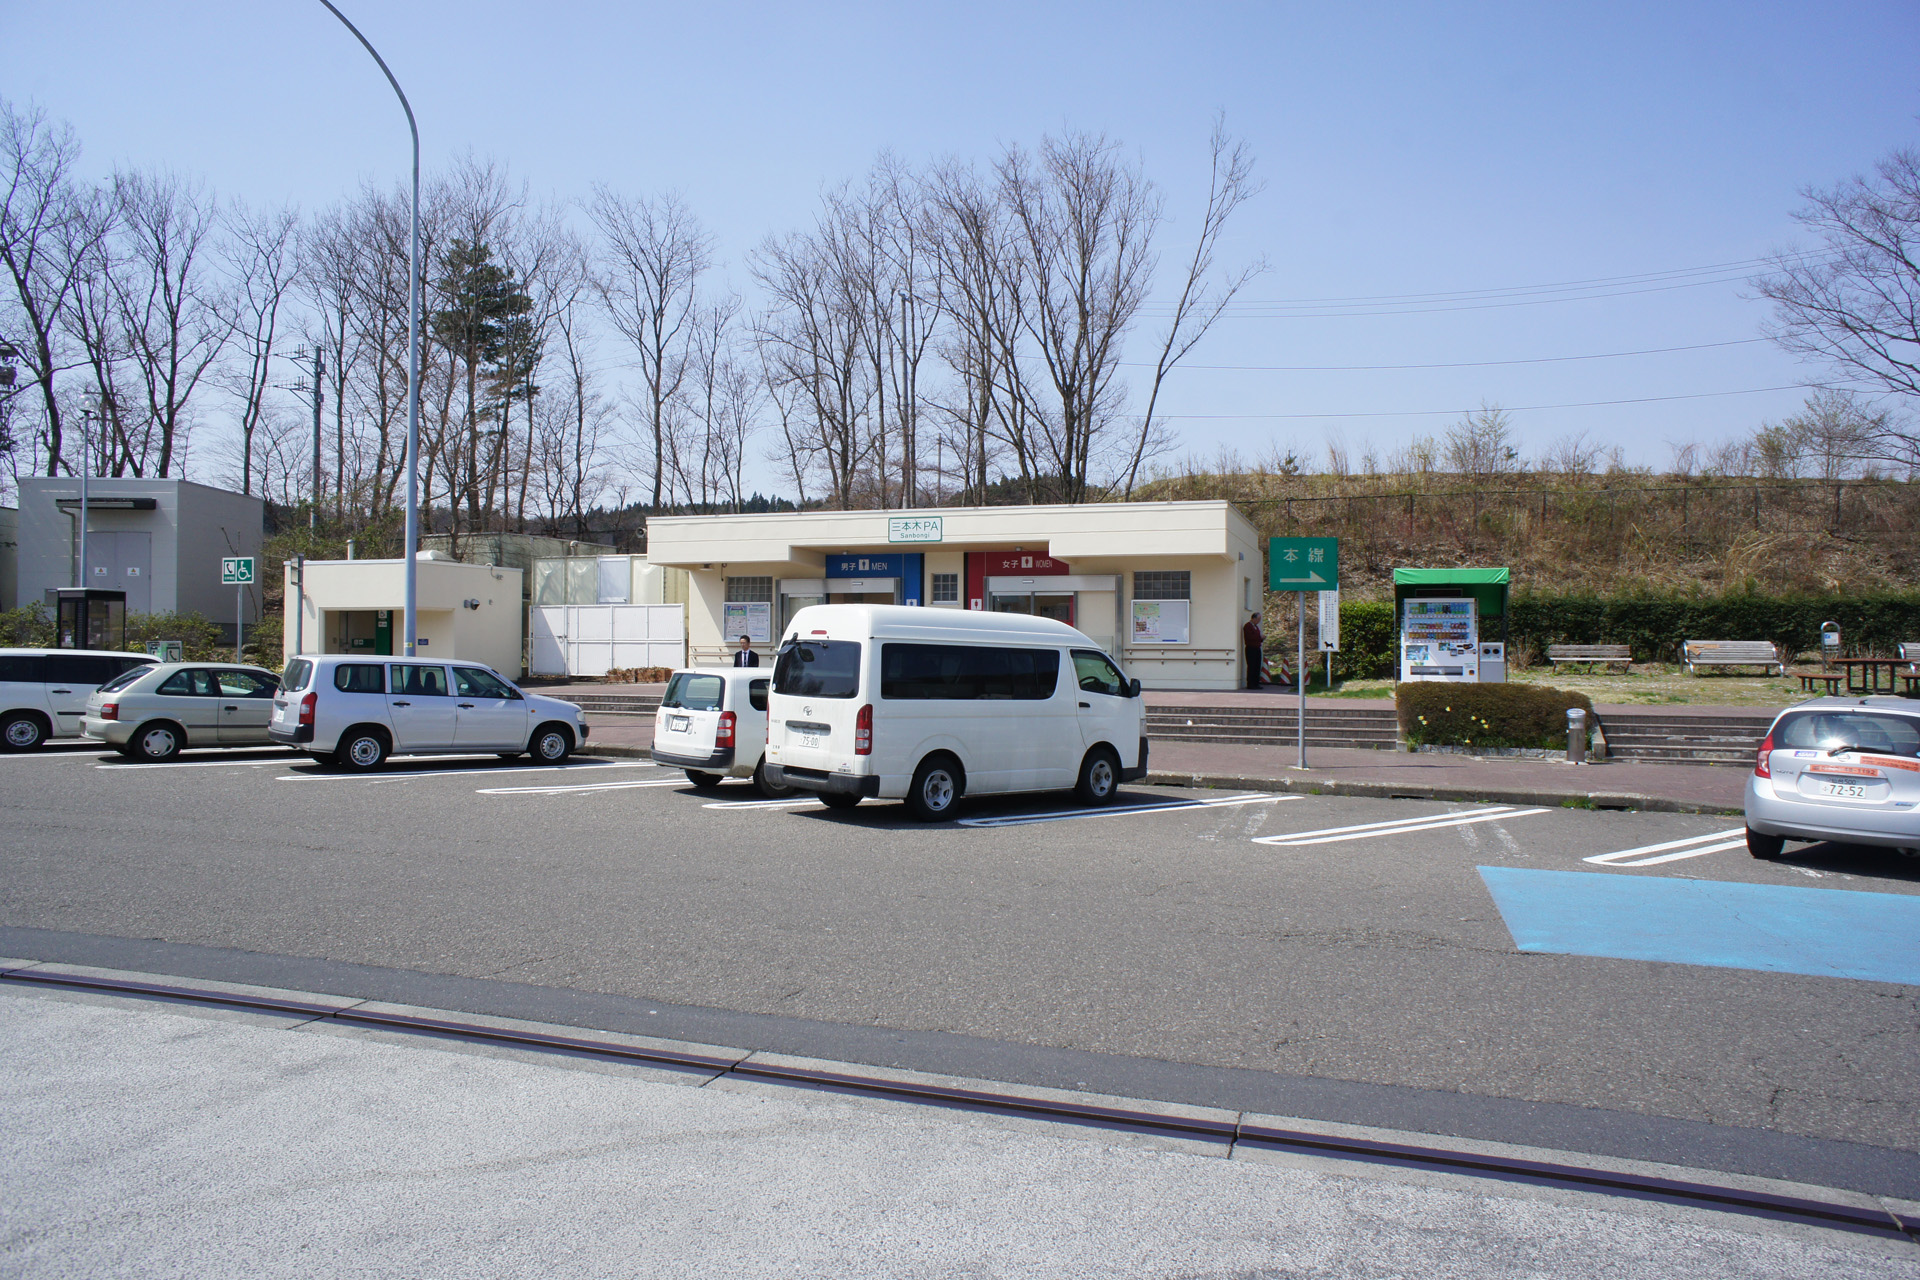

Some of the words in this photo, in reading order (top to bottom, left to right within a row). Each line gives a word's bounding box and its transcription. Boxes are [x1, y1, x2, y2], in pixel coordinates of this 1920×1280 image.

[891, 521, 939, 532] 三本木PA
[900, 532, 930, 540] Sanbongi
[1283, 547, 1324, 563] 本線
[841, 562, 857, 571] 男子
[871, 562, 888, 571] MEN
[1002, 559, 1019, 569] 女子
[1035, 559, 1053, 568] WOMEN
[1829, 784, 1864, 797] 72-52
